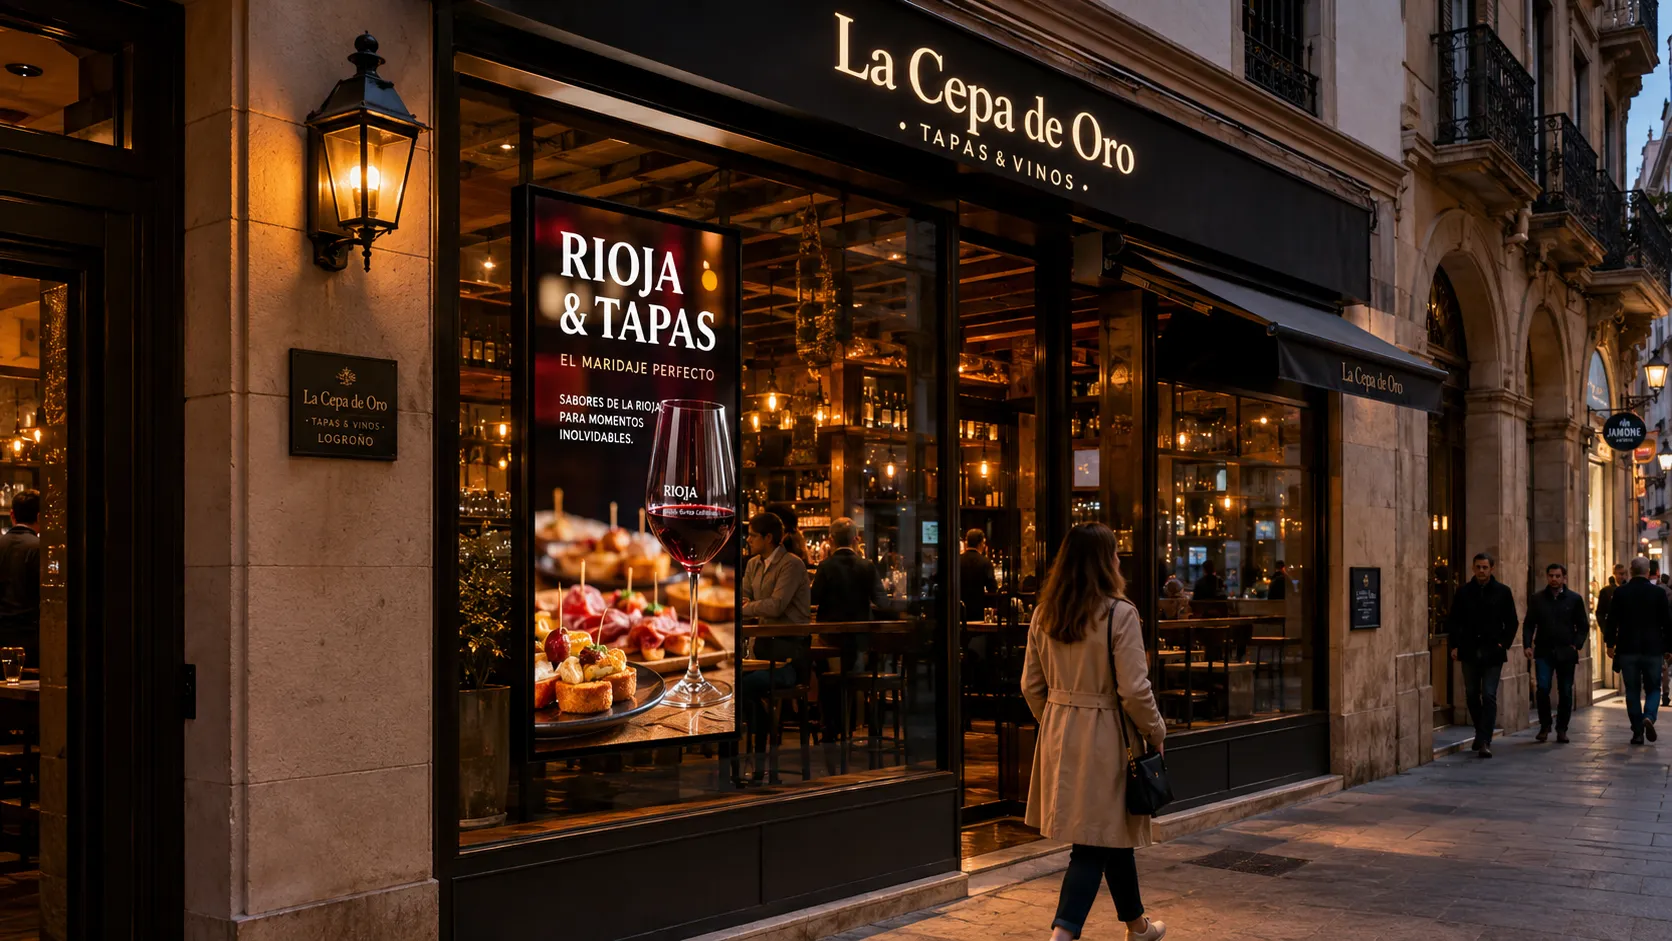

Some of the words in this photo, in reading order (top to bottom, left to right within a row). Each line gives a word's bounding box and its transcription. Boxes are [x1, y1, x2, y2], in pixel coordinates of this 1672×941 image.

[834, 12, 897, 91] La
[908, 47, 1015, 137] Cepa
[1024, 95, 1063, 149] de
[1072, 112, 1135, 175] Oro
[920, 123, 988, 162] TAPAS
[995, 150, 1006, 168] &
[1013, 154, 1074, 191] VINOS
[560, 230, 684, 298] RIOJA
[559, 292, 588, 336] &
[594, 295, 717, 352] TAPAS
[560, 353, 577, 367] EL
[582, 355, 648, 375] MARIDAJE
[653, 363, 715, 382] PERFECTO
[1341, 361, 1354, 383] La
[1355, 366, 1376, 393] Cepa
[1377, 372, 1387, 391] de
[1387, 374, 1404, 395] Oro
[303, 389, 318, 405] La
[320, 390, 349, 412] Cepa
[351, 394, 364, 409] de
[366, 395, 388, 411] Oro
[559, 393, 604, 408] SABORES
[607, 398, 619, 410] DE
[621, 399, 634, 411] LA
[311, 417, 340, 428] TAPAS
[343, 420, 349, 428] &
[352, 421, 380, 431] VINOS
[559, 411, 586, 424] PARA
[588, 414, 644, 428] MOMENTOS
[318, 433, 374, 447] LOGROÑO
[559, 429, 634, 444] INOLVIDABLES.
[663, 484, 699, 501] RIOJA
